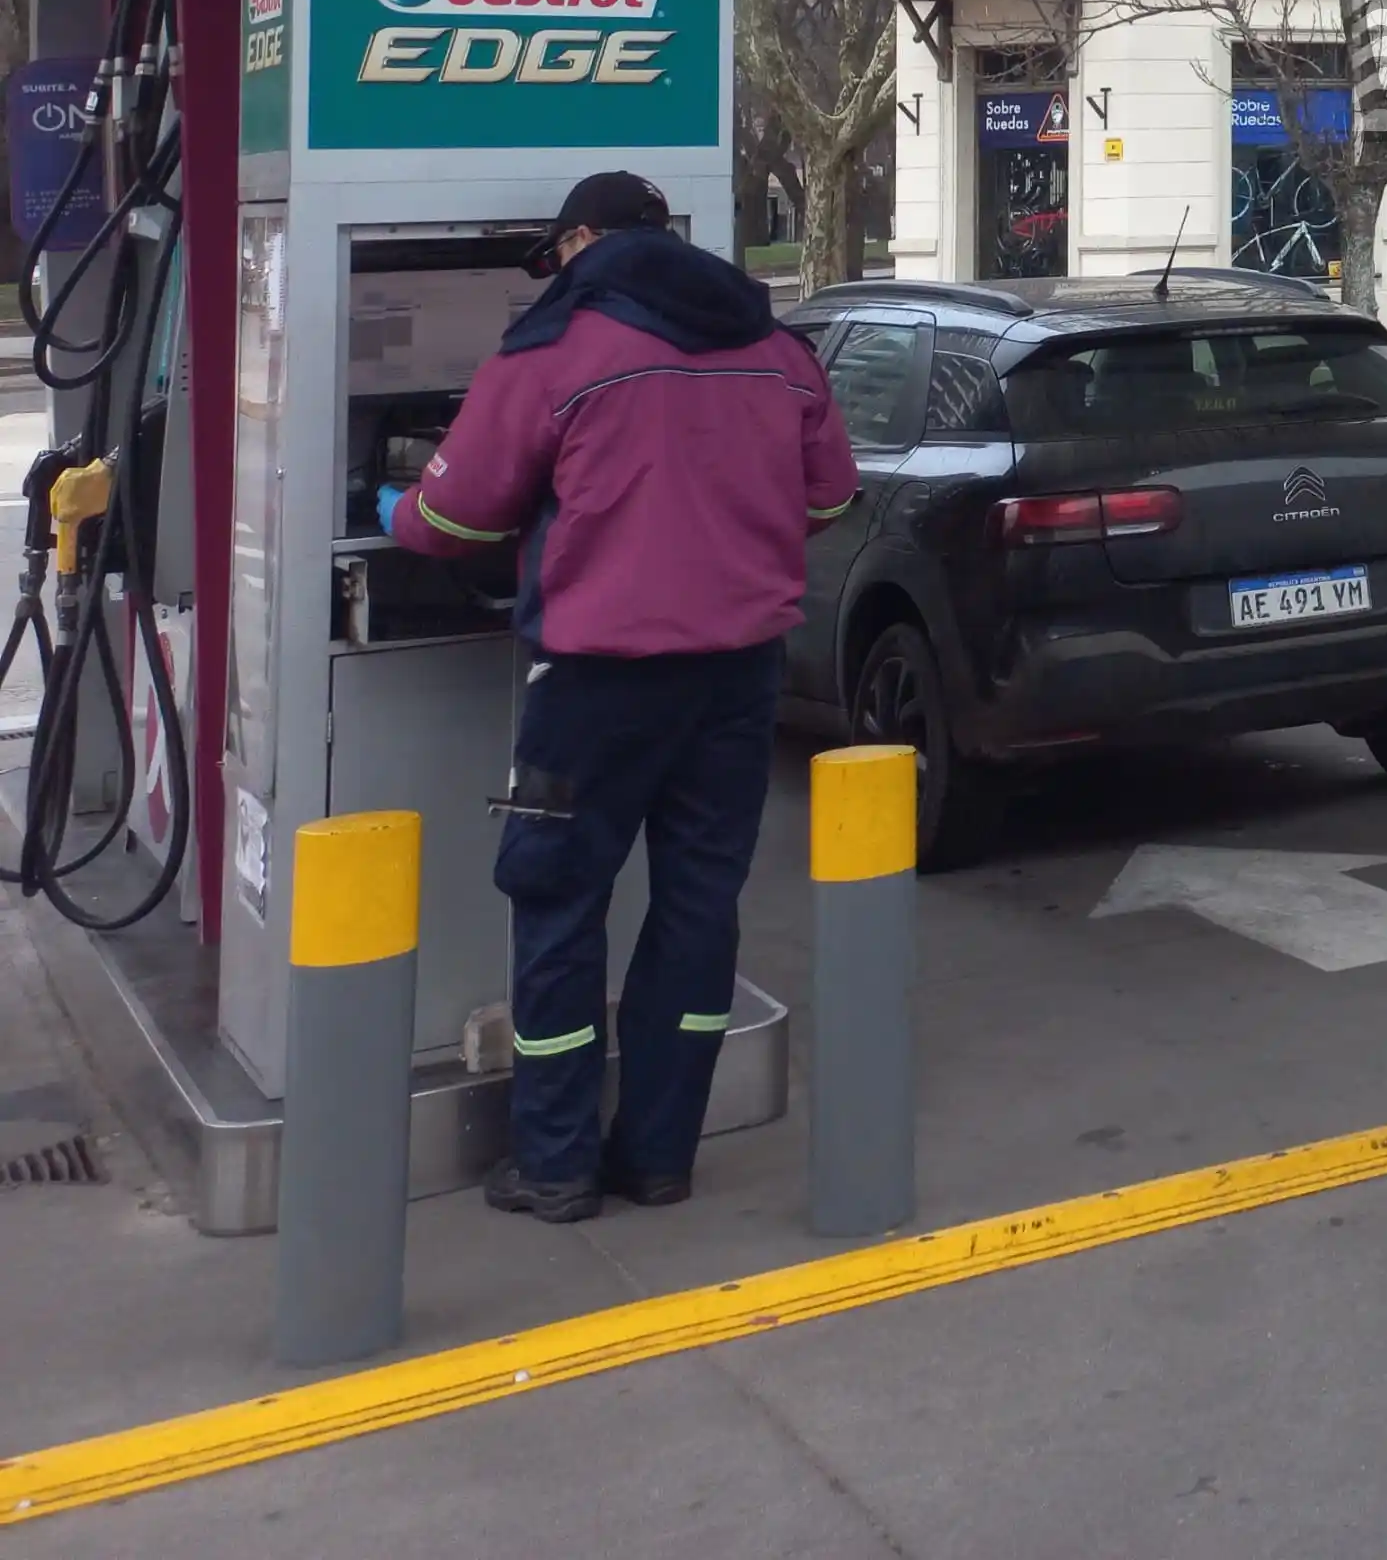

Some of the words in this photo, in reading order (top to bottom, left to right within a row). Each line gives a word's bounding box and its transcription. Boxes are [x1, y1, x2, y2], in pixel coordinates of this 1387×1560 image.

[246, 23, 285, 73] EDGE
[357, 26, 677, 84] EDGE
[986, 99, 1021, 115] Sobre
[1231, 98, 1271, 112] Sobre
[985, 116, 1029, 131] Ruedas
[1231, 112, 1283, 127] Ruedas
[1272, 506, 1341, 522] CITROËN
[1240, 592, 1271, 622] AE
[1279, 585, 1327, 616] 491
[1331, 579, 1364, 608] YM
